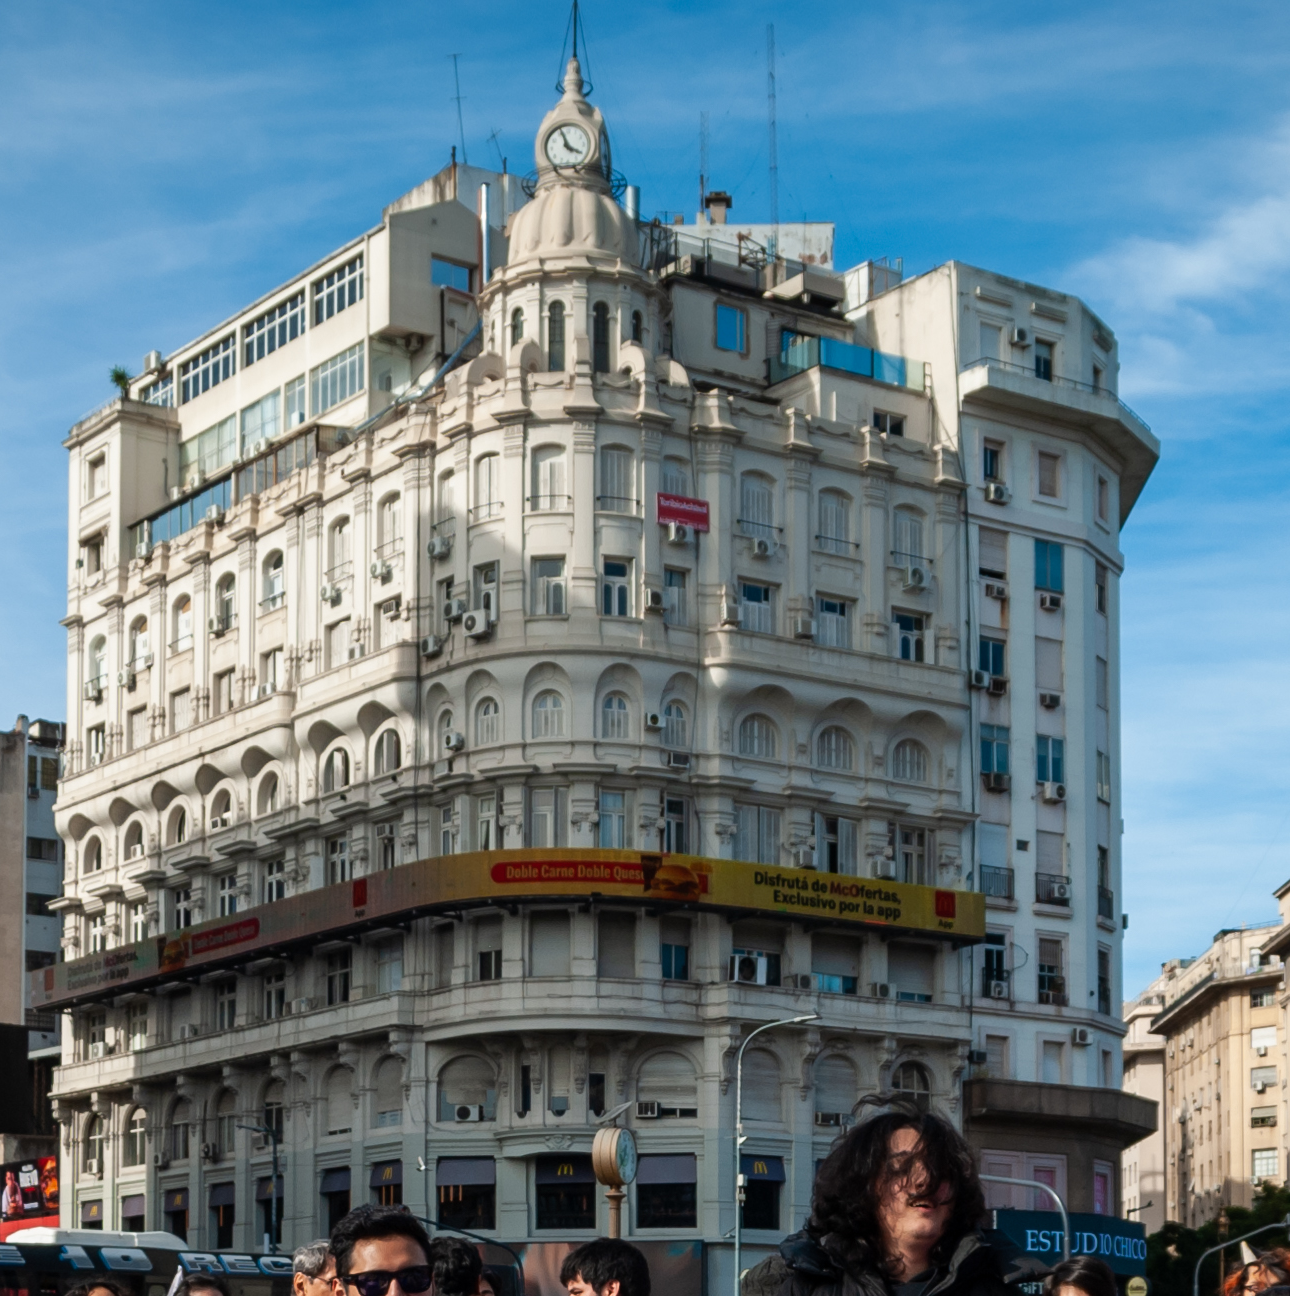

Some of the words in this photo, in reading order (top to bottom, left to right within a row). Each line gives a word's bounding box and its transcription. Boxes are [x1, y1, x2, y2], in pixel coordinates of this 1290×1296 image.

[506, 864, 539, 879] Doble
[541, 864, 575, 879] Carne
[577, 864, 610, 879] Doble
[754, 871, 808, 892] Disfrutá
[811, 880, 828, 893] de
[830, 881, 901, 904] McOfertas,
[773, 889, 836, 910] Exclusivo
[839, 897, 860, 915] por
[863, 901, 874, 914] la
[877, 905, 902, 921] app
[1113, 1235, 1147, 1260] CHICO
